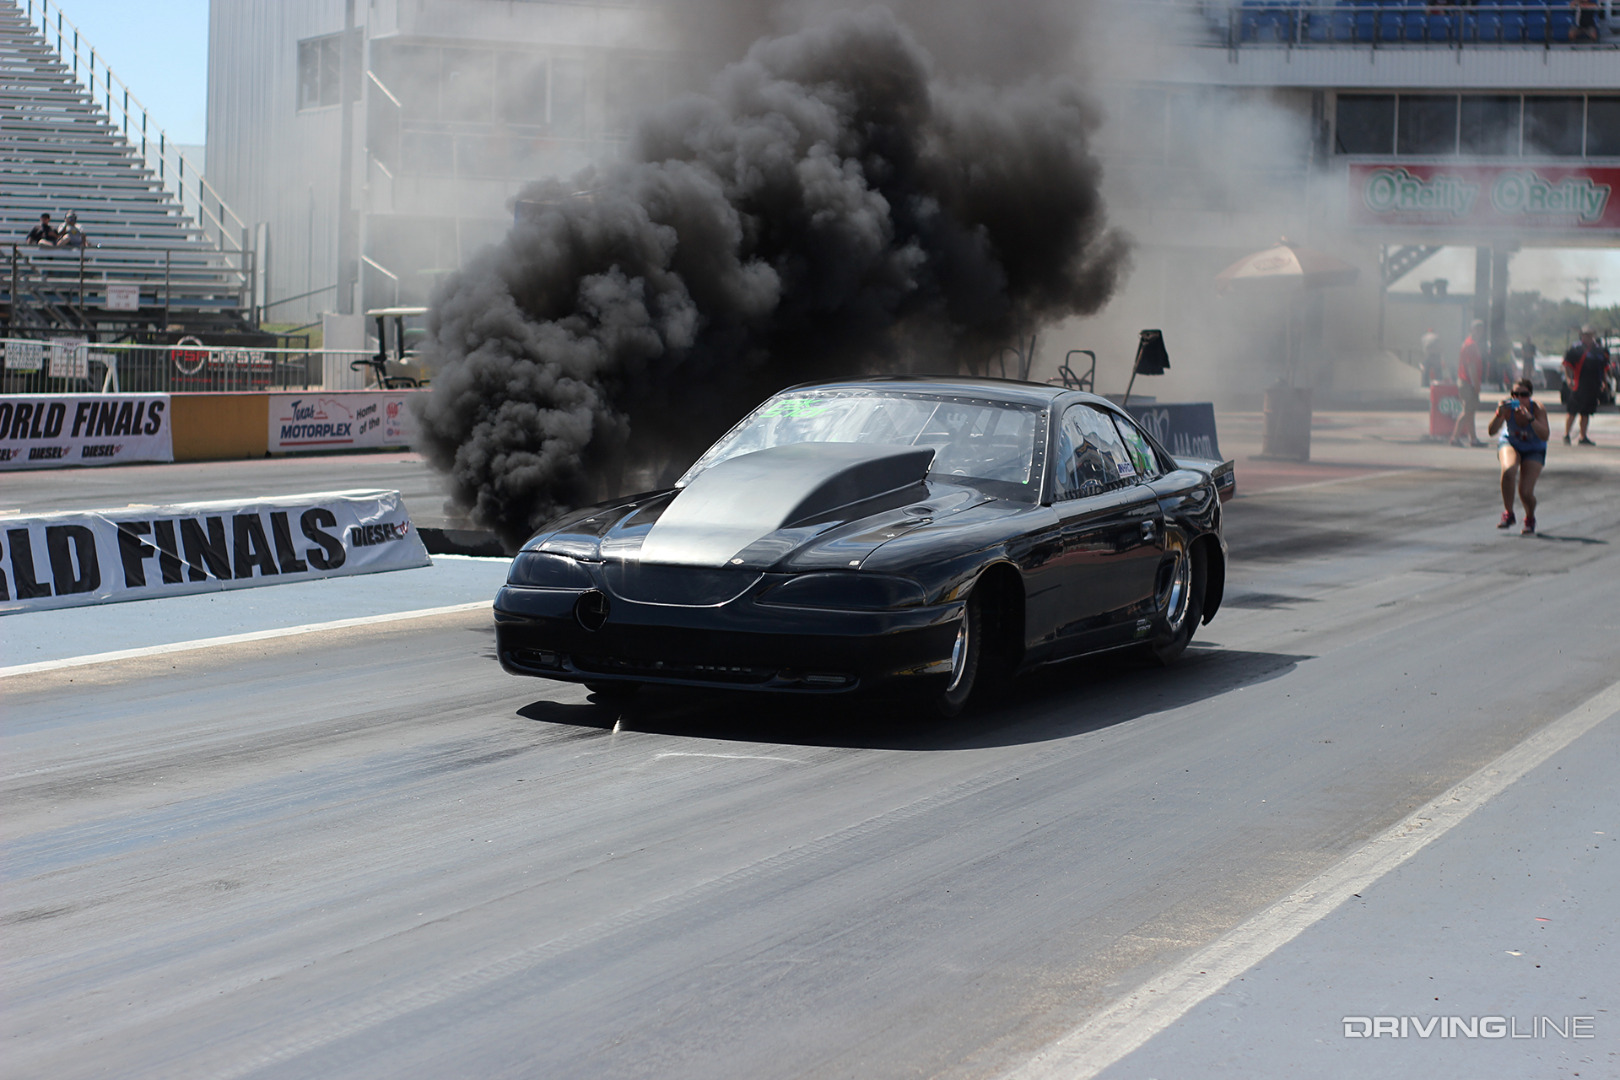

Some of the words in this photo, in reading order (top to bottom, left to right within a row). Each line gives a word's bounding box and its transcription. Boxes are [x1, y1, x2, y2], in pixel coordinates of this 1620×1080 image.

[71, 400, 165, 438] FINALS
[291, 400, 315, 424] Texas
[356, 403, 377, 420] Home
[280, 423, 352, 439] MOTORPLEX
[359, 424, 367, 435] of
[369, 417, 380, 430] the
[81, 444, 115, 458] DIESEL
[350, 522, 404, 548] DIESEL
[0, 525, 100, 601] LD
[115, 507, 346, 588] FINALS
